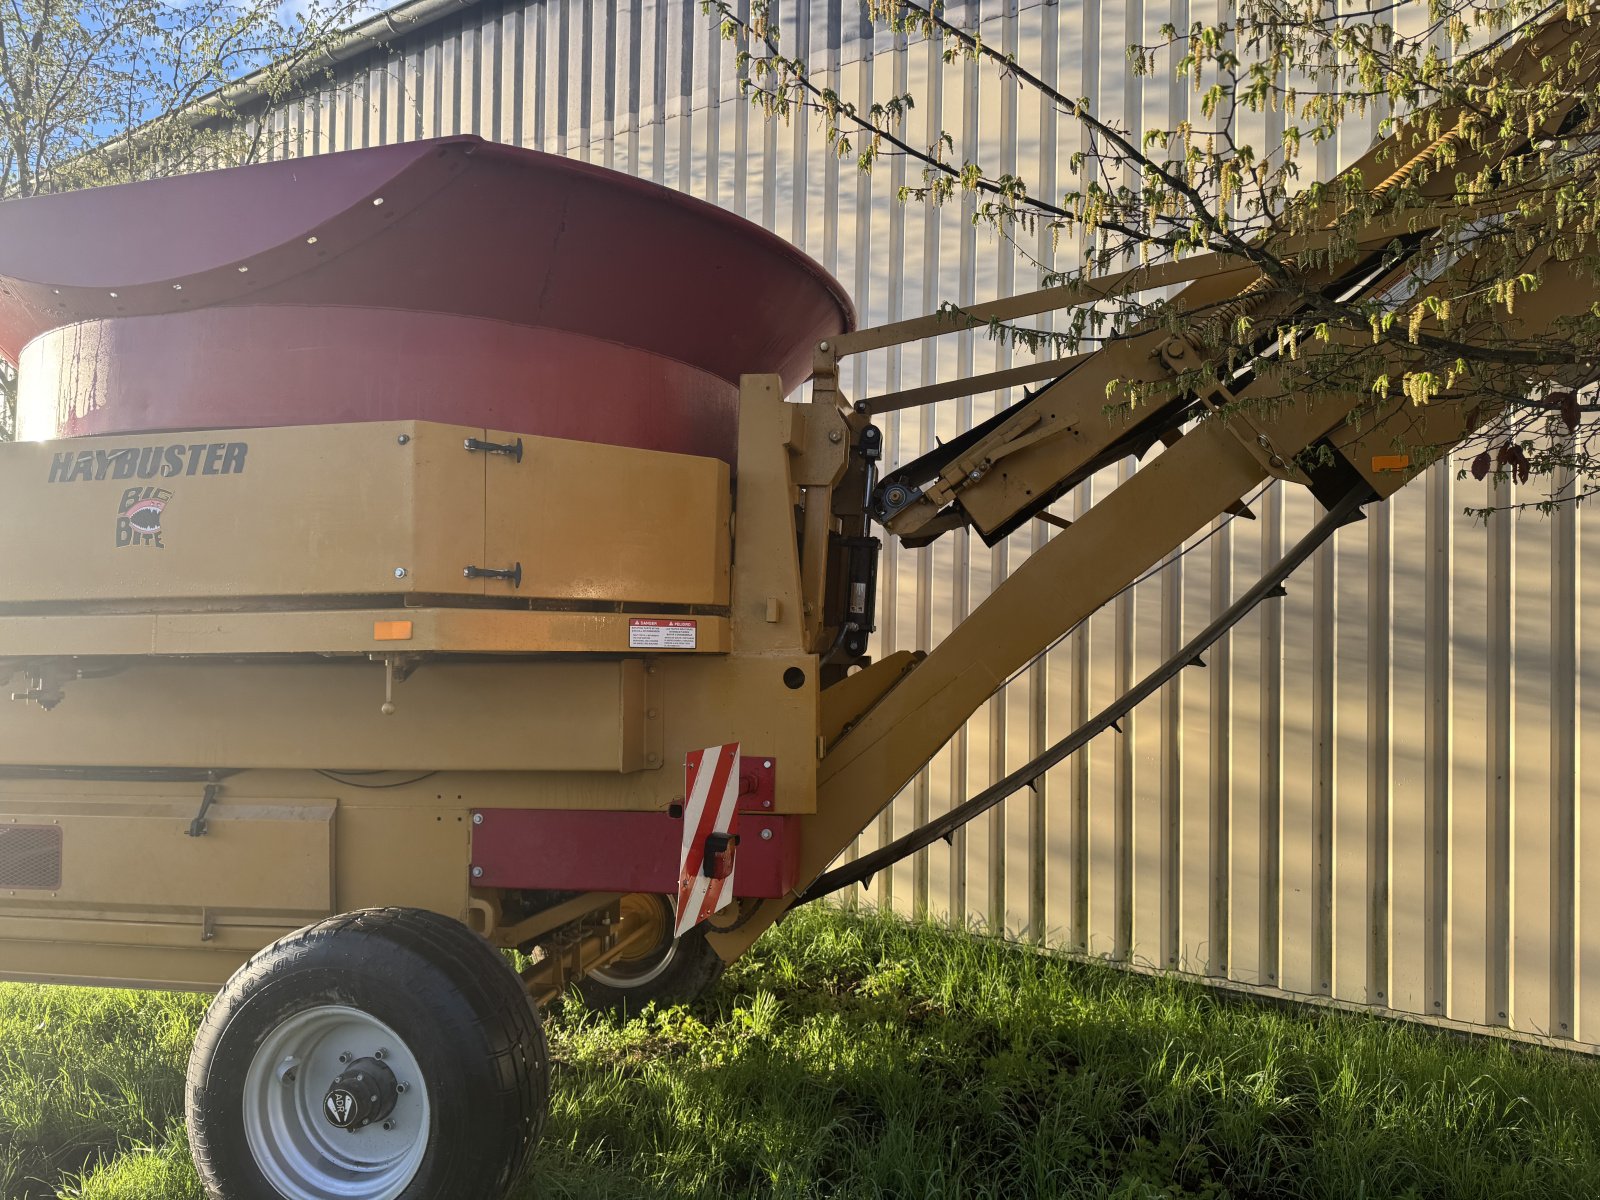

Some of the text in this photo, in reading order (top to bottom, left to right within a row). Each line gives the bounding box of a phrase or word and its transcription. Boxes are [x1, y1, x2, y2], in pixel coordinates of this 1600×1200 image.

[48, 442, 248, 483] HAYBUSTER
[118, 486, 175, 514] BIG
[116, 516, 164, 549] BITE
[335, 1093, 345, 1113] ADR
